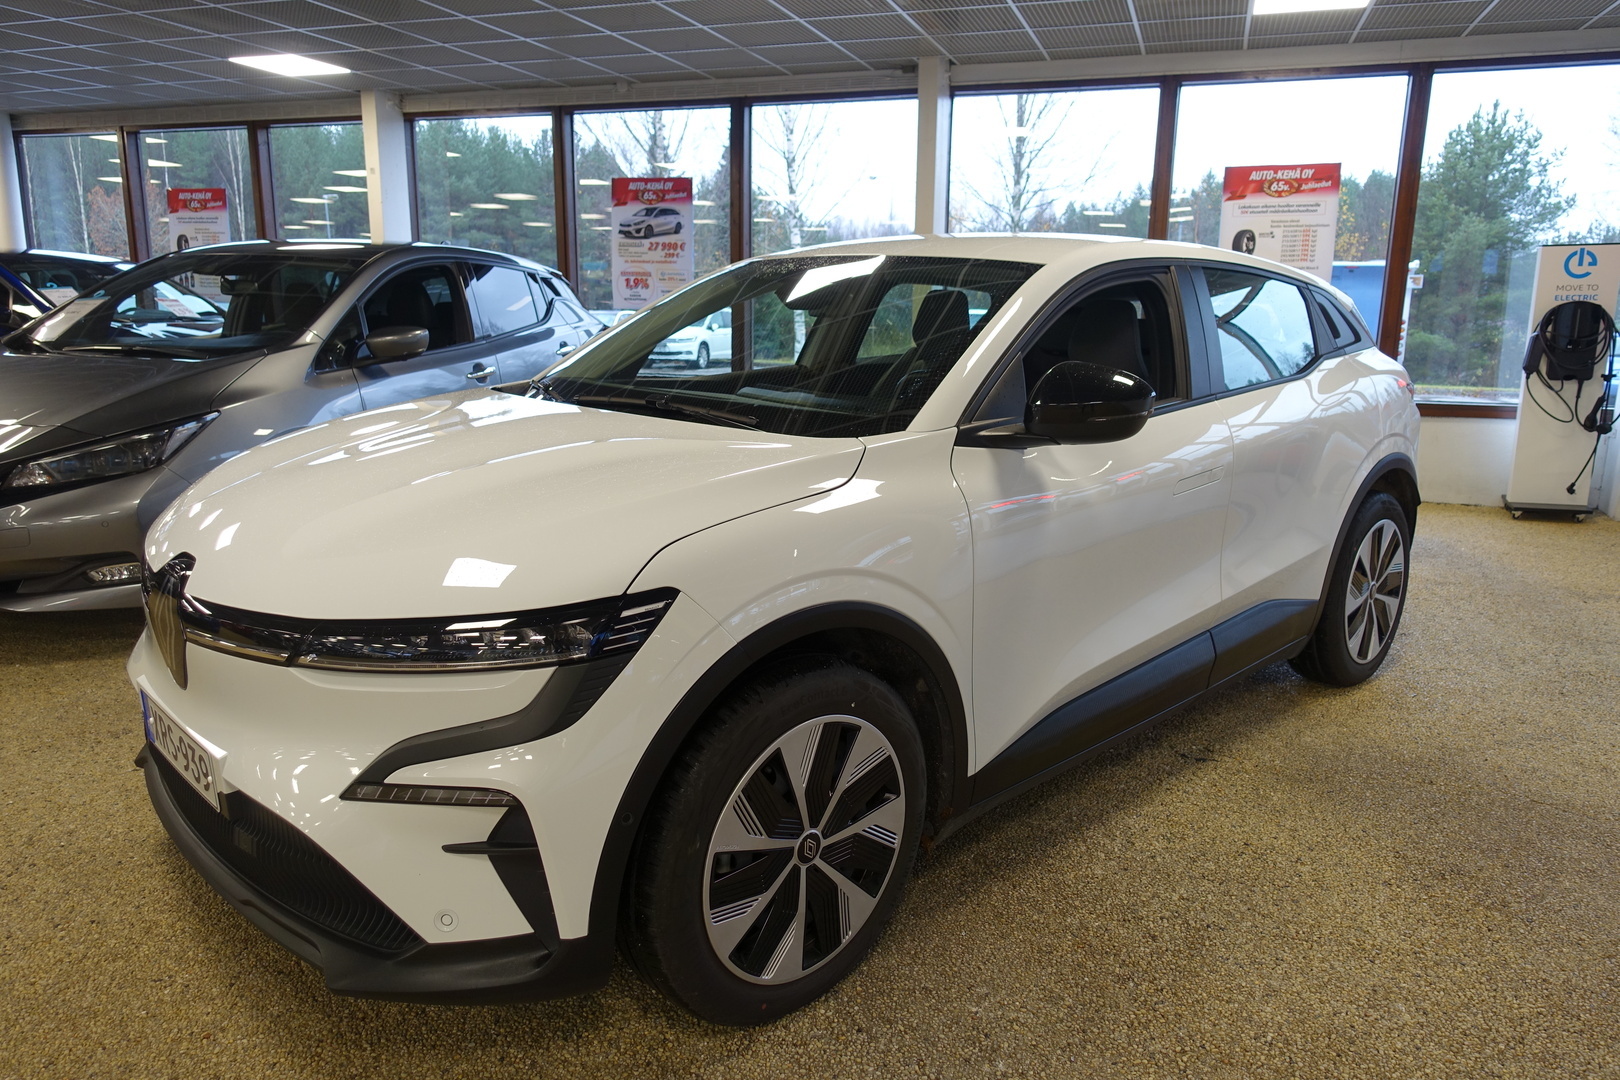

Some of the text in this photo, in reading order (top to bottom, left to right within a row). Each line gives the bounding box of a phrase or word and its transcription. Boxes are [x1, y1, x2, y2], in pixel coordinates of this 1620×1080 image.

[1249, 168, 1314, 180] AUTO-KEHÄ OY
[628, 180, 674, 190] AUTO-KEHÄ OY
[1270, 181, 1290, 191] 65v.
[1300, 180, 1332, 190] Juhlaedut
[178, 191, 205, 200] AUTO-KEHÄ
[644, 192, 657, 200] 65v.
[648, 242, 660, 251] 27
[661, 242, 678, 252] 990
[679, 242, 686, 251] €
[624, 278, 650, 290] 1,9%
[150, 705, 211, 791] XRS-939
